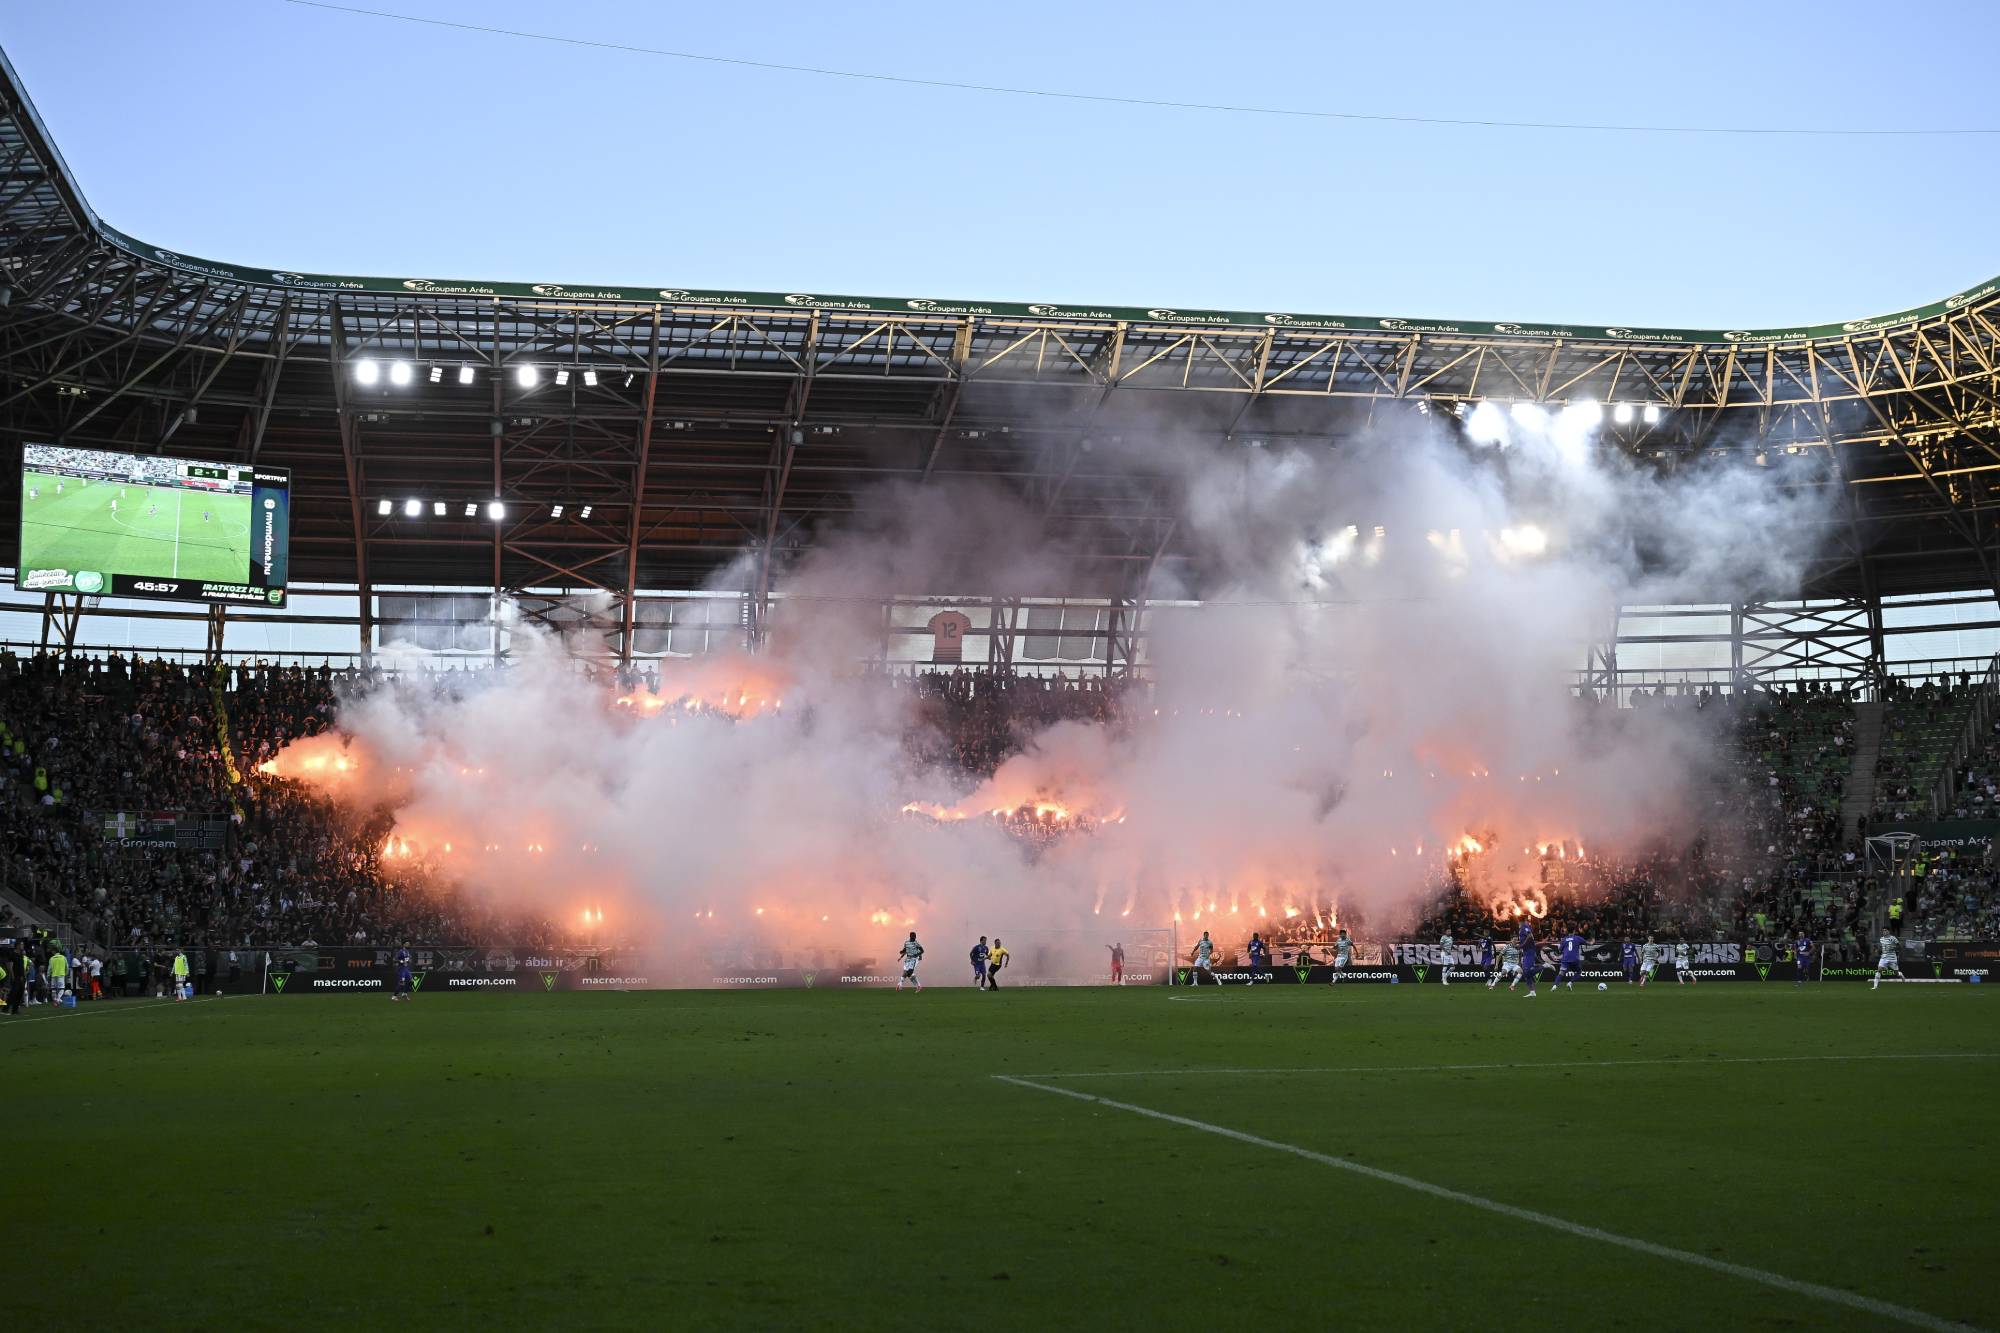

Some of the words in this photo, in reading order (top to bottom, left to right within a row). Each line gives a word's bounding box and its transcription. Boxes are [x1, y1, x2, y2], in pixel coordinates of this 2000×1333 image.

[172, 259, 208, 273] Groupama
[211, 268, 233, 278] Aréna
[294, 279, 336, 288] Groupama
[425, 285, 466, 294] Groupama
[554, 290, 595, 299] Groupama
[597, 291, 621, 299] Aréna
[680, 294, 721, 304] Groupama
[1958, 292, 1981, 306] Groupama
[805, 300, 846, 309] Groupama
[928, 305, 967, 314] Groupama
[1049, 310, 1087, 318] Groupama
[1168, 314, 1206, 323] Groupama
[1208, 315, 1230, 323] Aréna
[1284, 319, 1321, 327] Groupama
[1862, 319, 1898, 331] Groupama
[1900, 314, 1919, 323] Aréna
[1398, 324, 1436, 332] Groupama
[1513, 328, 1550, 337] Groupama
[1624, 332, 1660, 341] Groupama
[1743, 334, 1781, 342] Groupama
[1784, 331, 1806, 340] Aréna
[254, 474, 287, 482] SPORTFIVE
[264, 512, 274, 575] mvmdome.hu
[134, 582, 178, 593] 45:57
[202, 584, 247, 593] IRATKOZZ
[942, 622, 957, 638] 12
[121, 837, 175, 848] Groupam
[1920, 839, 1964, 848] oupama
[314, 978, 381, 987] macron.com
[450, 977, 516, 986] macron.com
